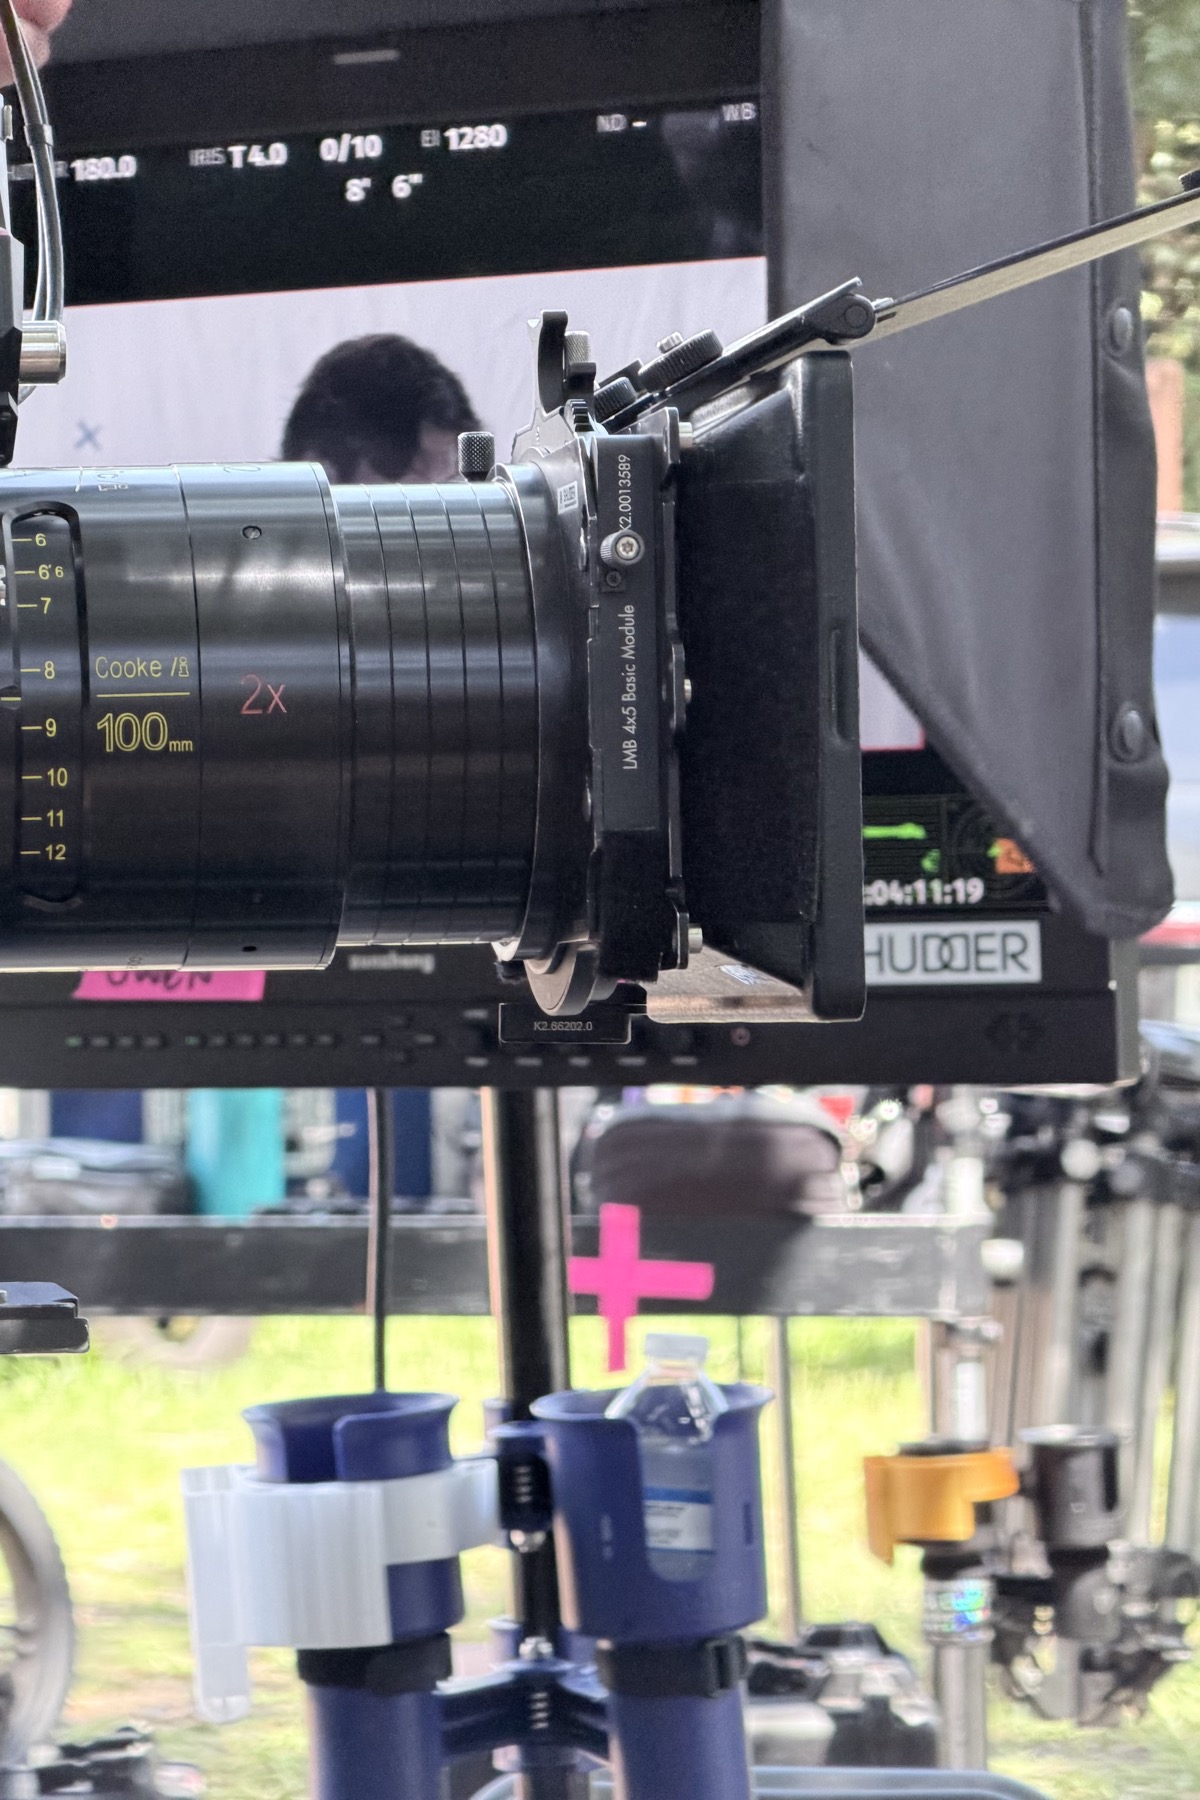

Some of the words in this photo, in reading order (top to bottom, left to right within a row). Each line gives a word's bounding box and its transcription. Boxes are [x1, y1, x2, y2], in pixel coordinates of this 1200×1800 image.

[319, 133, 383, 164] 0/10
[444, 124, 508, 151] 1280
[70, 155, 138, 181] 180.0
[35, 533, 47, 547] 6
[40, 597, 52, 614] 7
[617, 604, 636, 660] Module
[44, 661, 56, 680] 8
[95, 655, 162, 679] Cooke
[621, 663, 637, 702] Basic
[45, 718, 58, 738] 9
[622, 706, 637, 735] 4x5
[622, 739, 638, 770] LMB
[47, 767, 69, 787] 10
[46, 809, 64, 827] 11
[45, 843, 67, 861] 12
